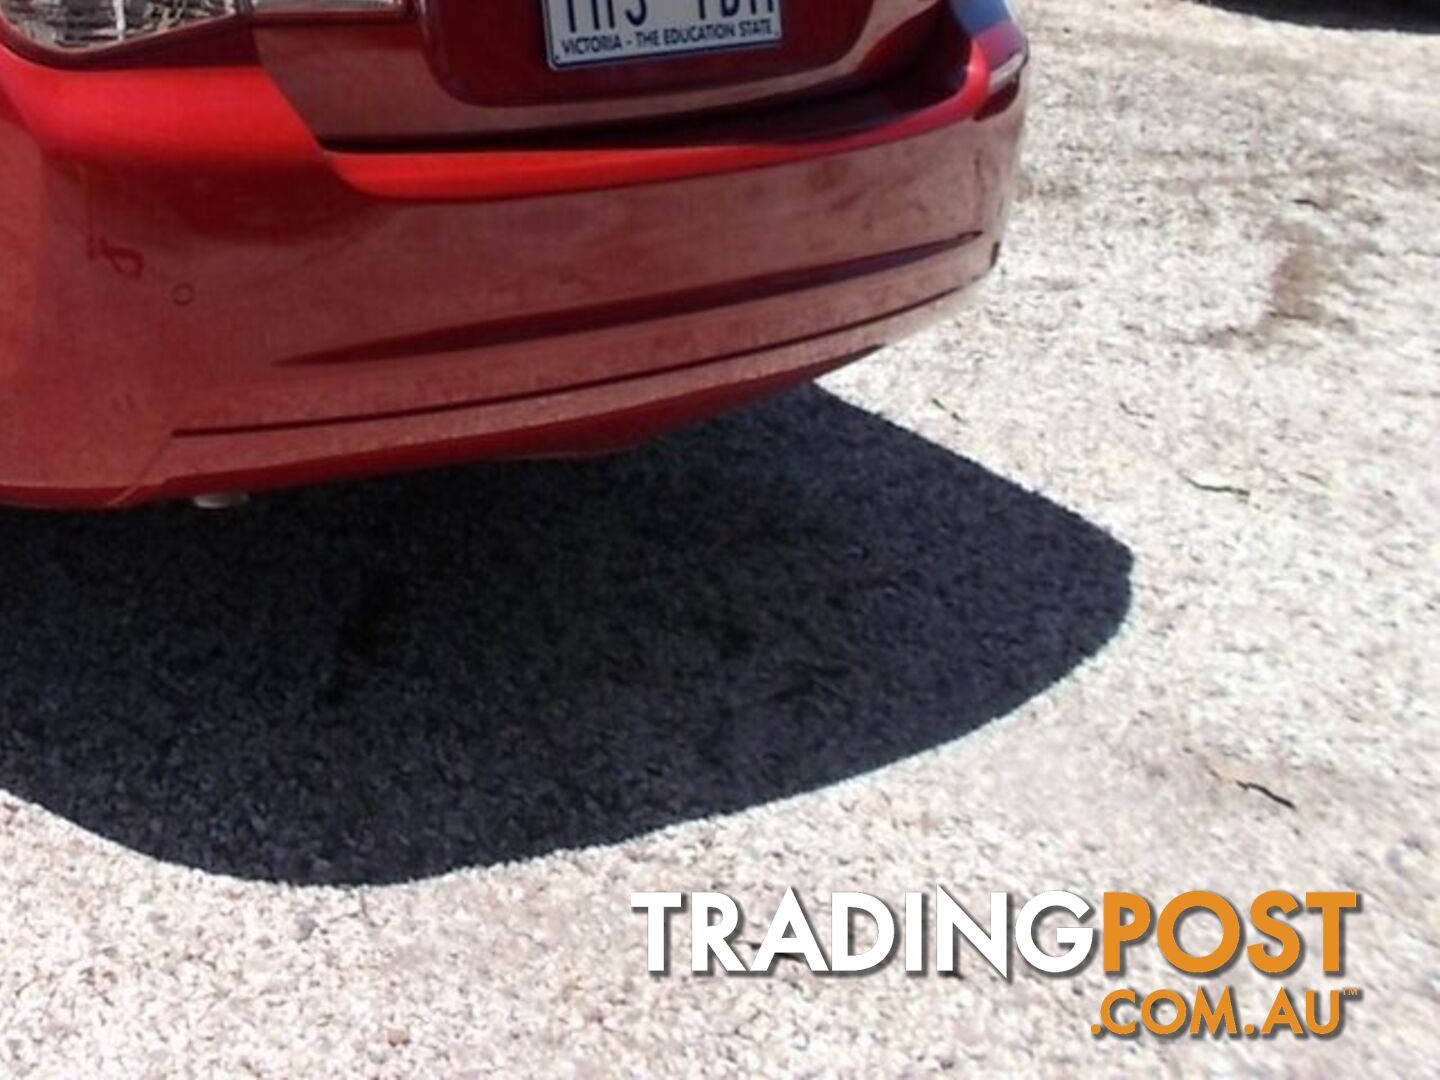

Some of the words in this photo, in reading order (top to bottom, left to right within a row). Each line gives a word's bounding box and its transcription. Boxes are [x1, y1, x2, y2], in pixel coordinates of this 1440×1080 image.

[561, 34, 623, 56] VICTORIA
[635, 30, 660, 47] THE
[663, 21, 736, 46] EDUCATION
[738, 18, 773, 39] STATE
